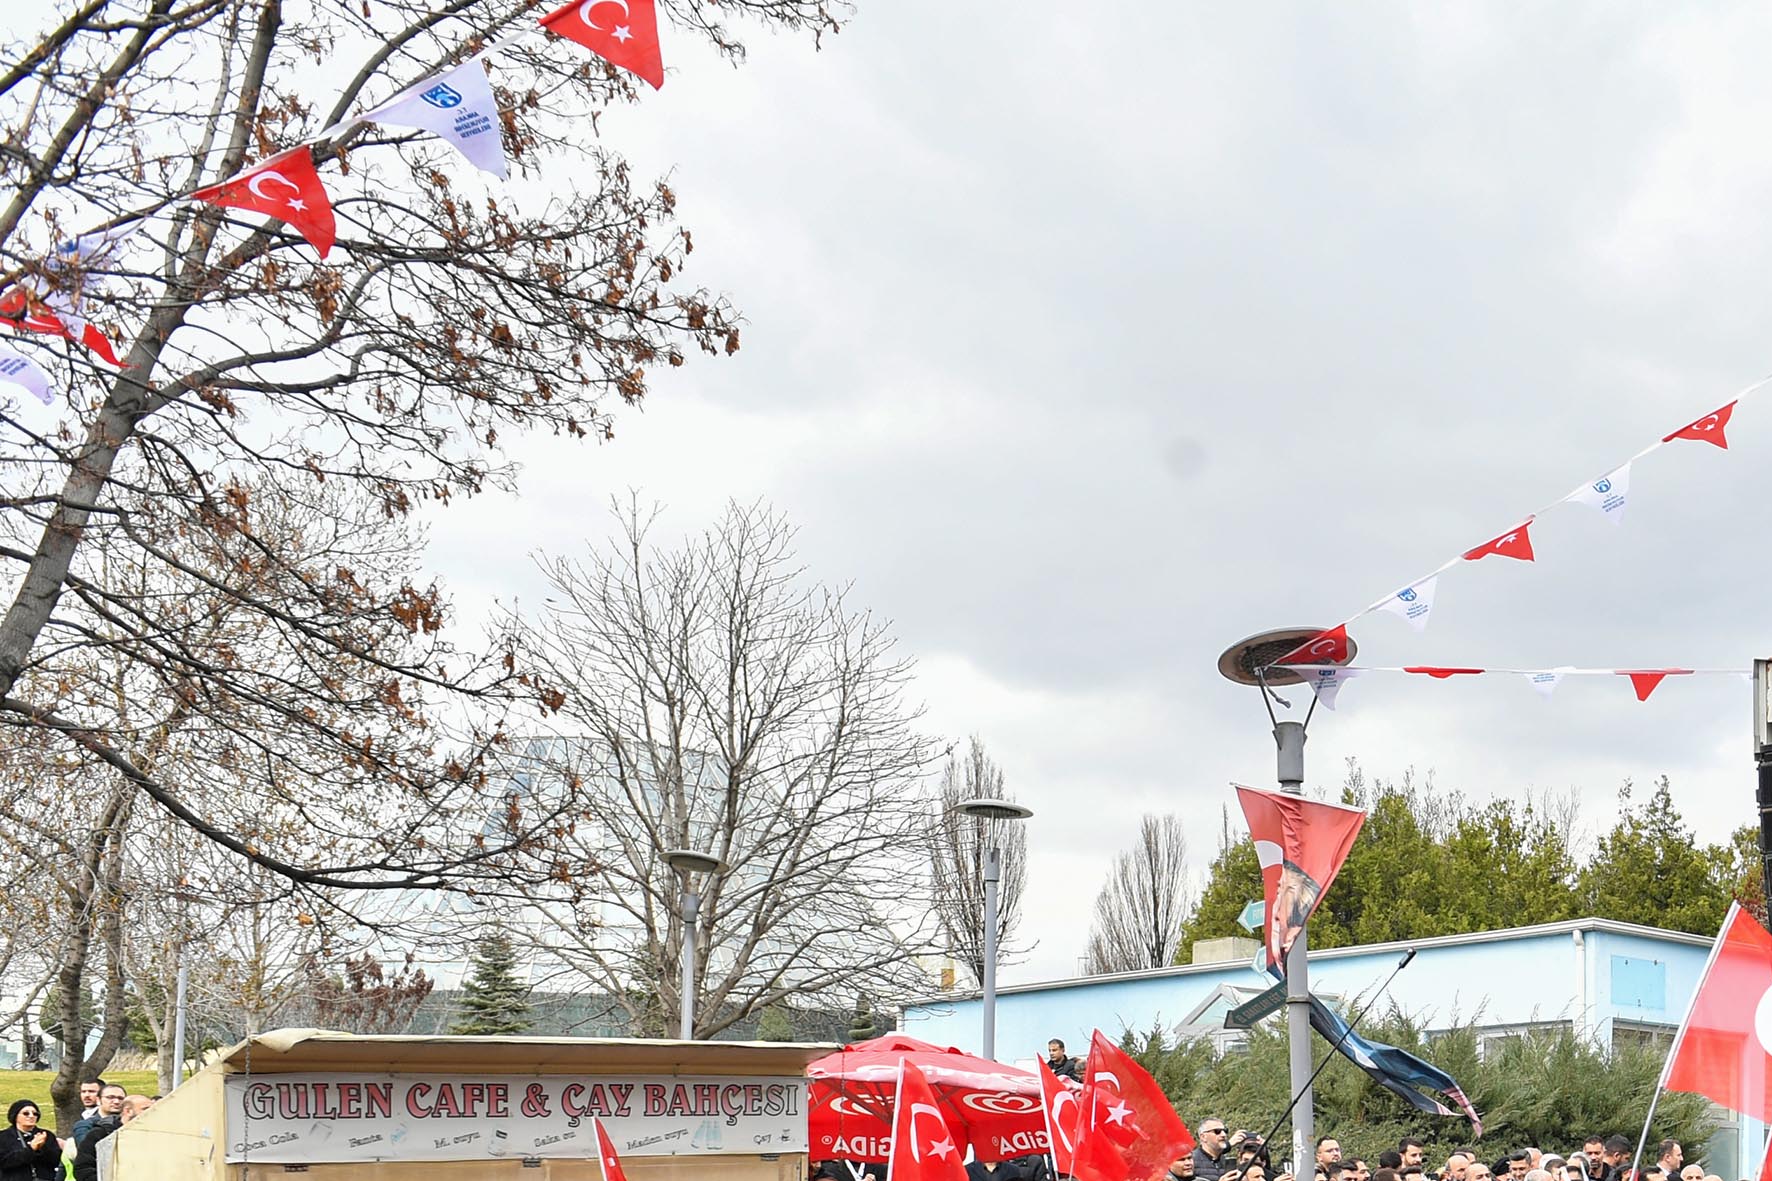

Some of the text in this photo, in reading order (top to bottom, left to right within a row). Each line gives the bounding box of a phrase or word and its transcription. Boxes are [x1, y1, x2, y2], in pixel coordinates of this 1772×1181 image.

[406, 1083, 508, 1118] CAFE
[521, 1083, 551, 1118] &
[562, 1083, 633, 1127] ÇAY
[269, 1131, 299, 1145] Cola
[349, 1133, 383, 1148] Fanta
